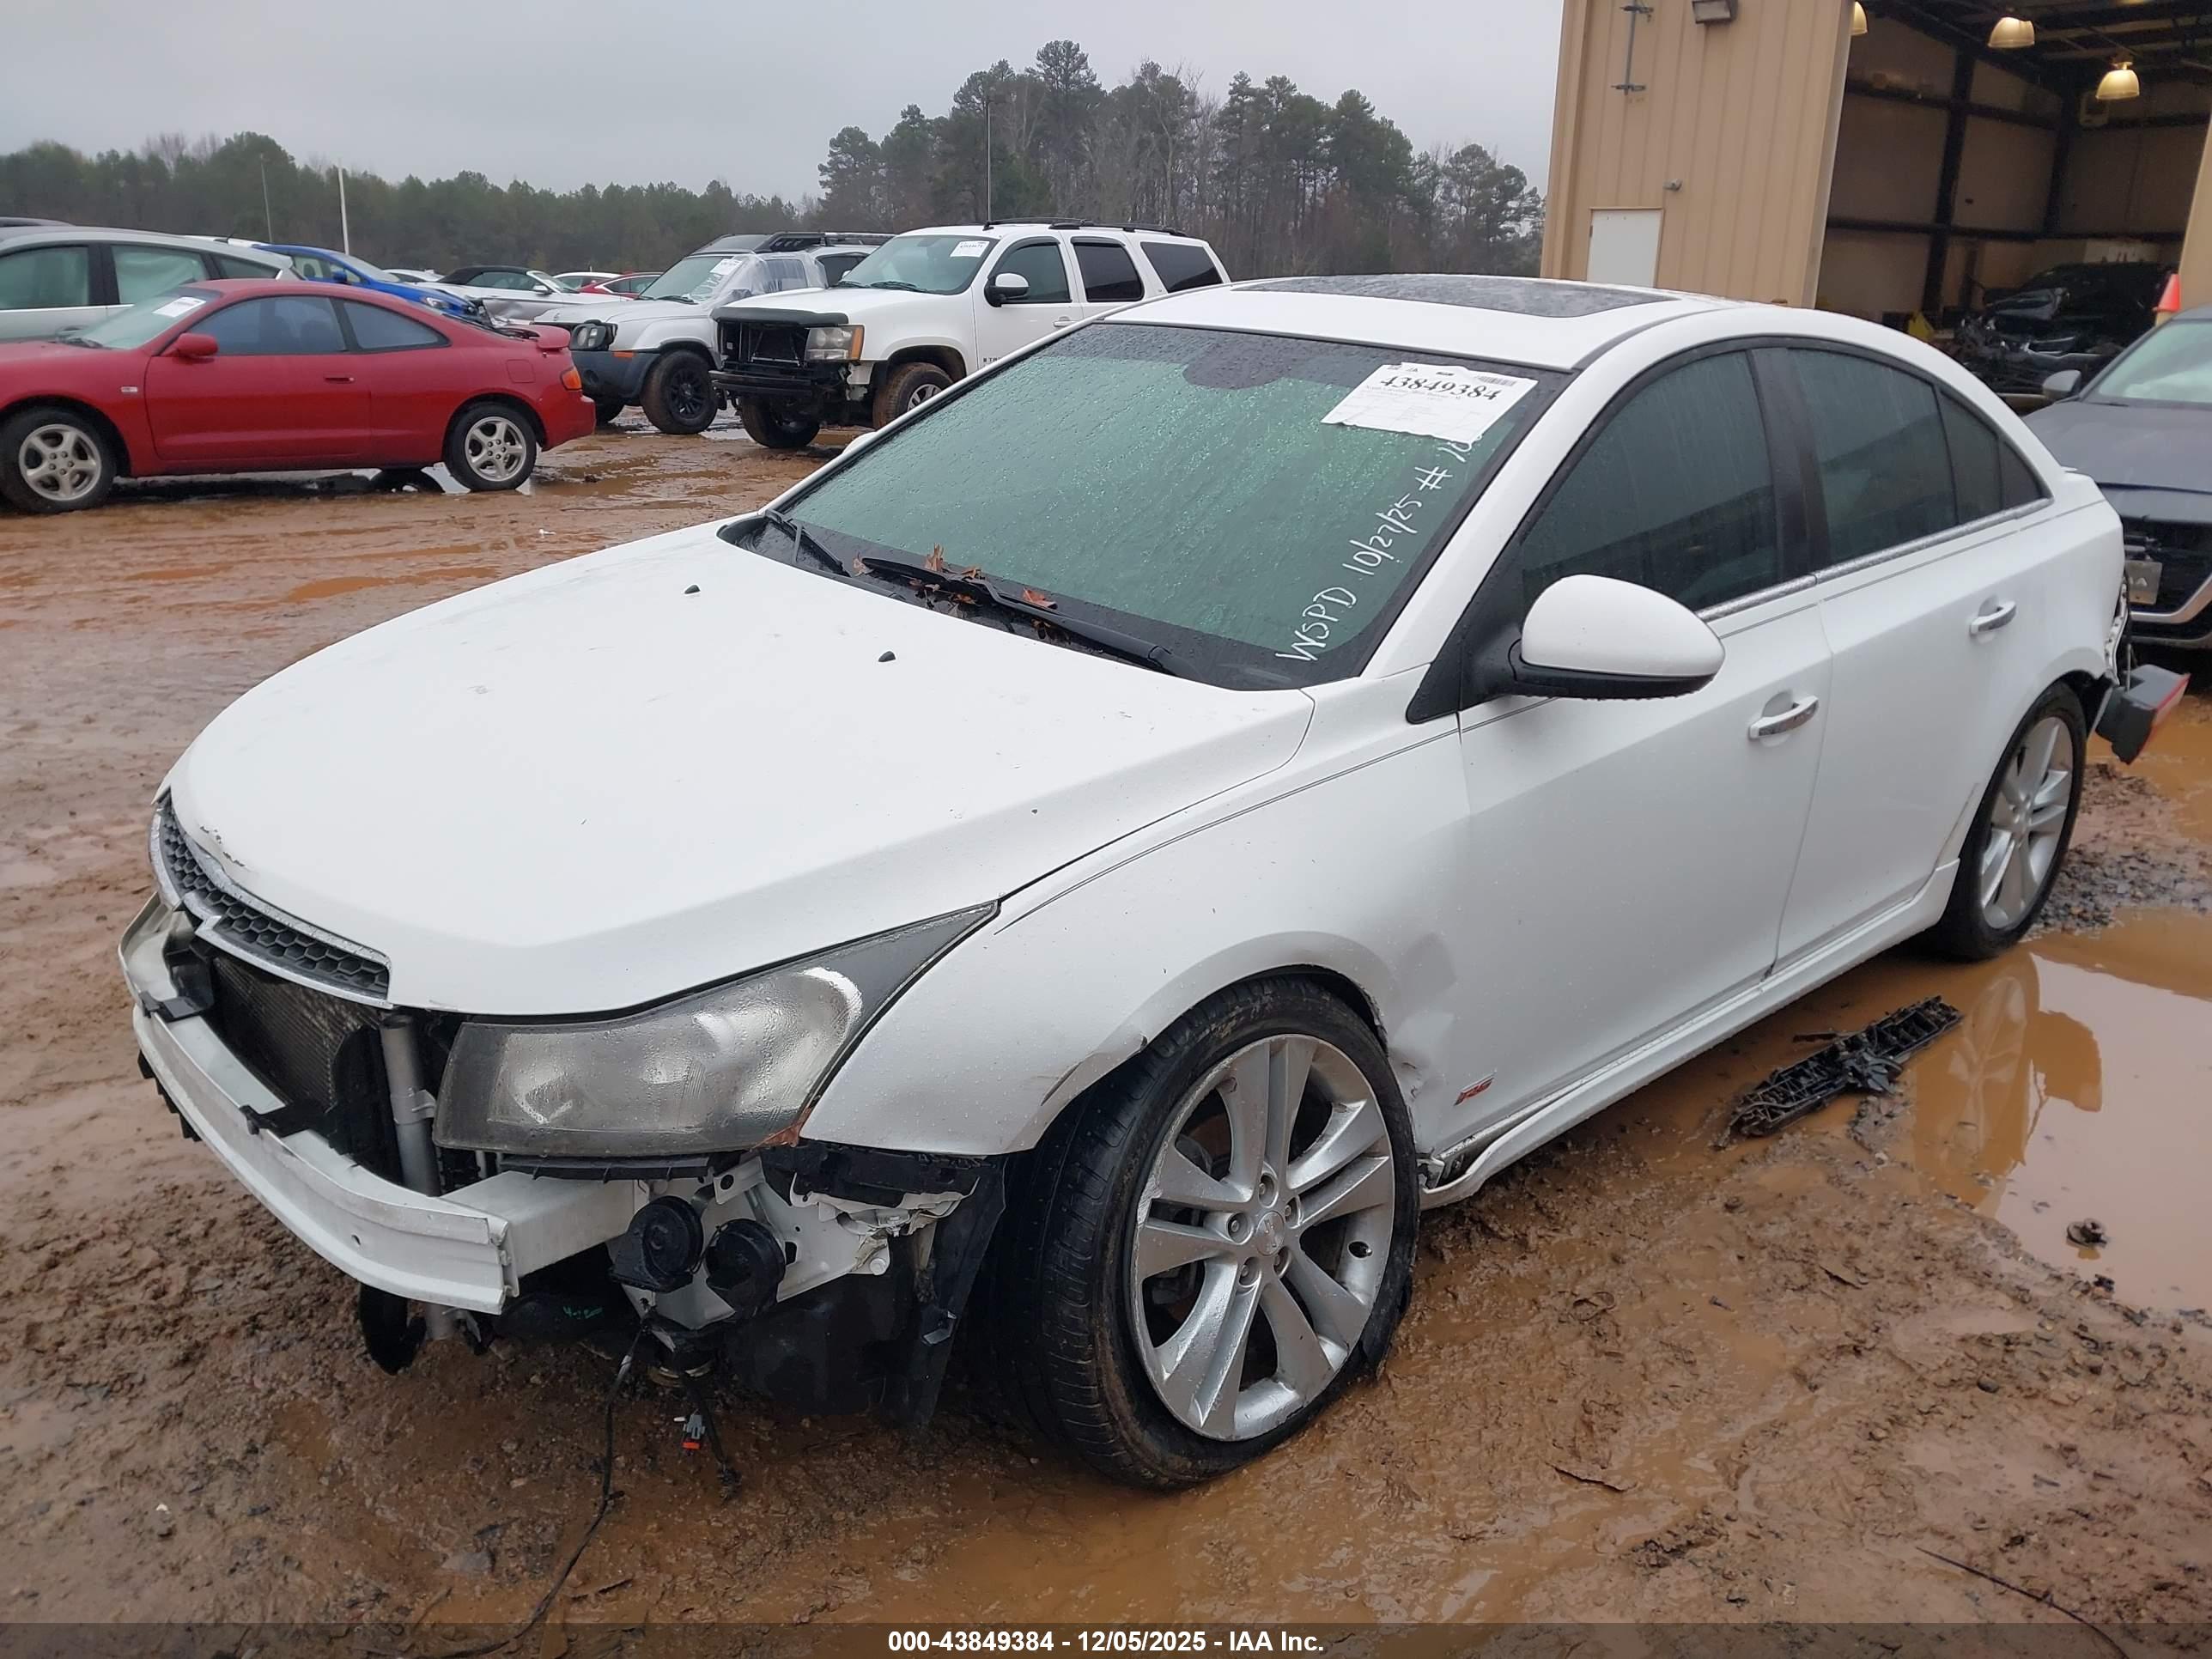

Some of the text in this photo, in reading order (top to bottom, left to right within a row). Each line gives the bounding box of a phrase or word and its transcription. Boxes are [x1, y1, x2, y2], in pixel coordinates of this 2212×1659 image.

[1380, 374, 1502, 401] 43849384
[1274, 586, 1357, 661] WSPD
[1414, 466, 1453, 490] #
